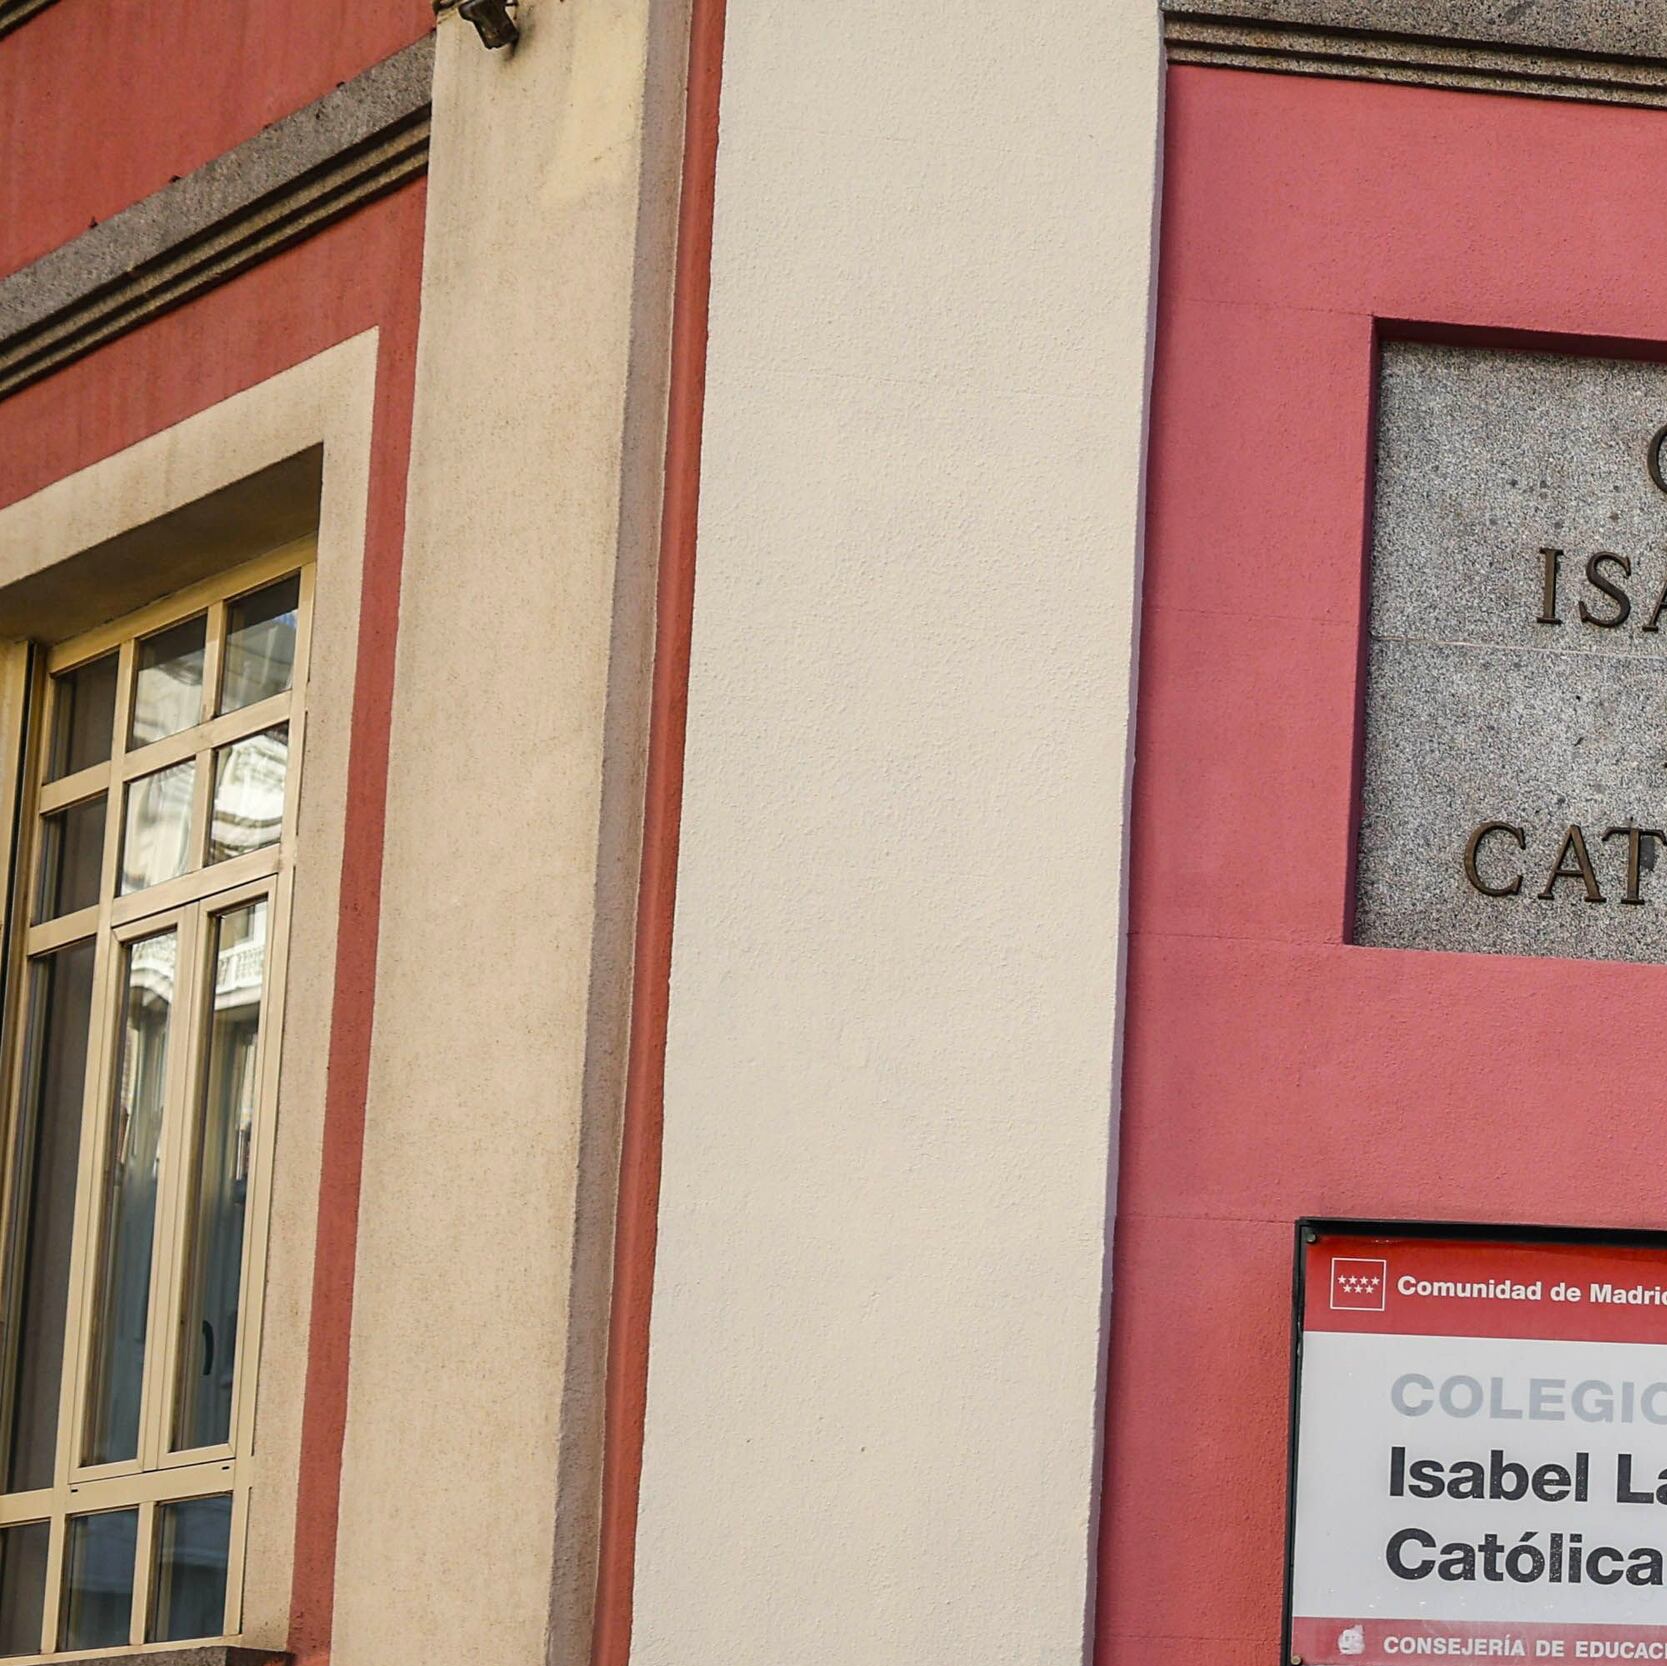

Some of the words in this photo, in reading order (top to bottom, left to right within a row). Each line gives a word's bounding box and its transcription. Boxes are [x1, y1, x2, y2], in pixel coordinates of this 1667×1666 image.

[1397, 1275, 1542, 1300] Comunidad
[1550, 1282, 1582, 1302] de
[1389, 1446, 1590, 1502] Isabel
[1386, 1528, 1664, 1586] Católica
[1383, 1634, 1525, 1658] CONSEJERÍA
[1535, 1640, 1565, 1658] DE
